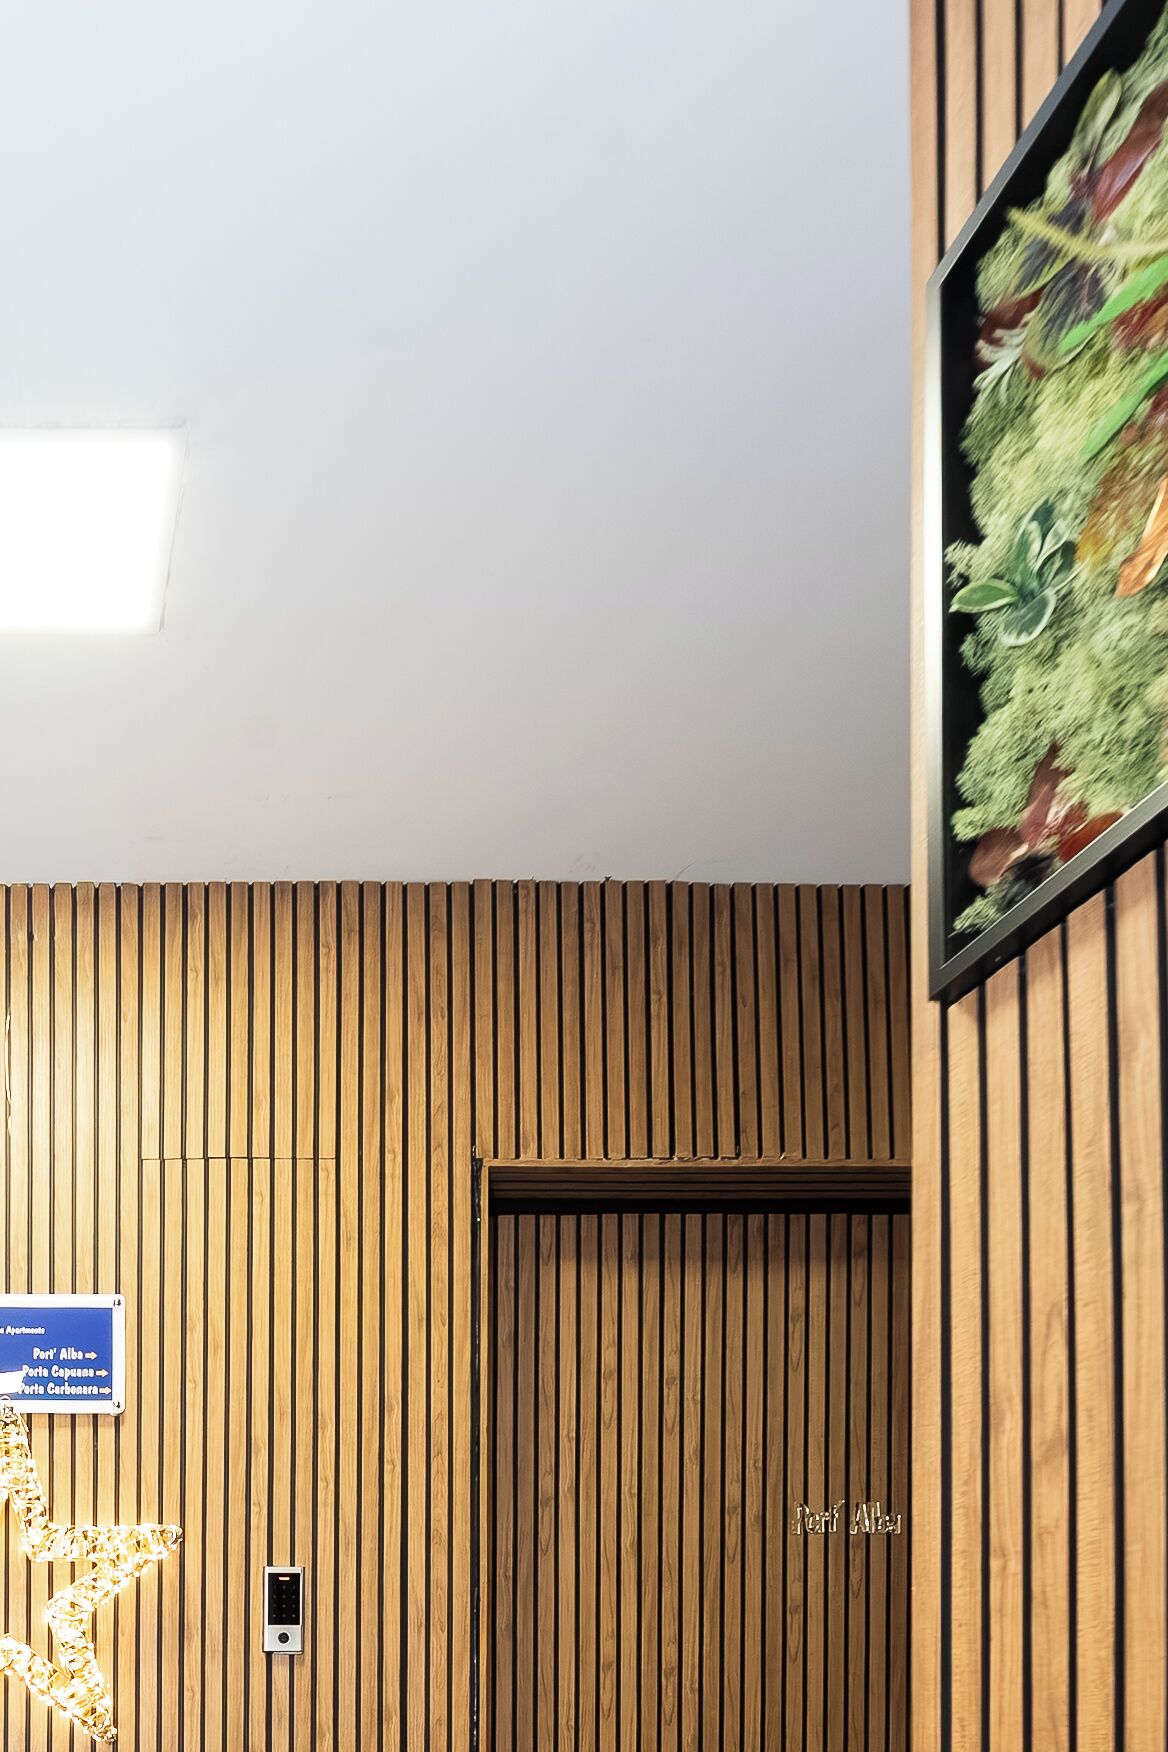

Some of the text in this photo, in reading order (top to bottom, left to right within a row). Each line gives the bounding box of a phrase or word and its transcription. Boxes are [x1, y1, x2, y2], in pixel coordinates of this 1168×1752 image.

[5, 1325, 46, 1336] Apartments
[59, 1347, 84, 1360] Alba
[22, 1364, 94, 1381] Porta Capuana
[18, 1381, 99, 1395] Porta Carbonara
